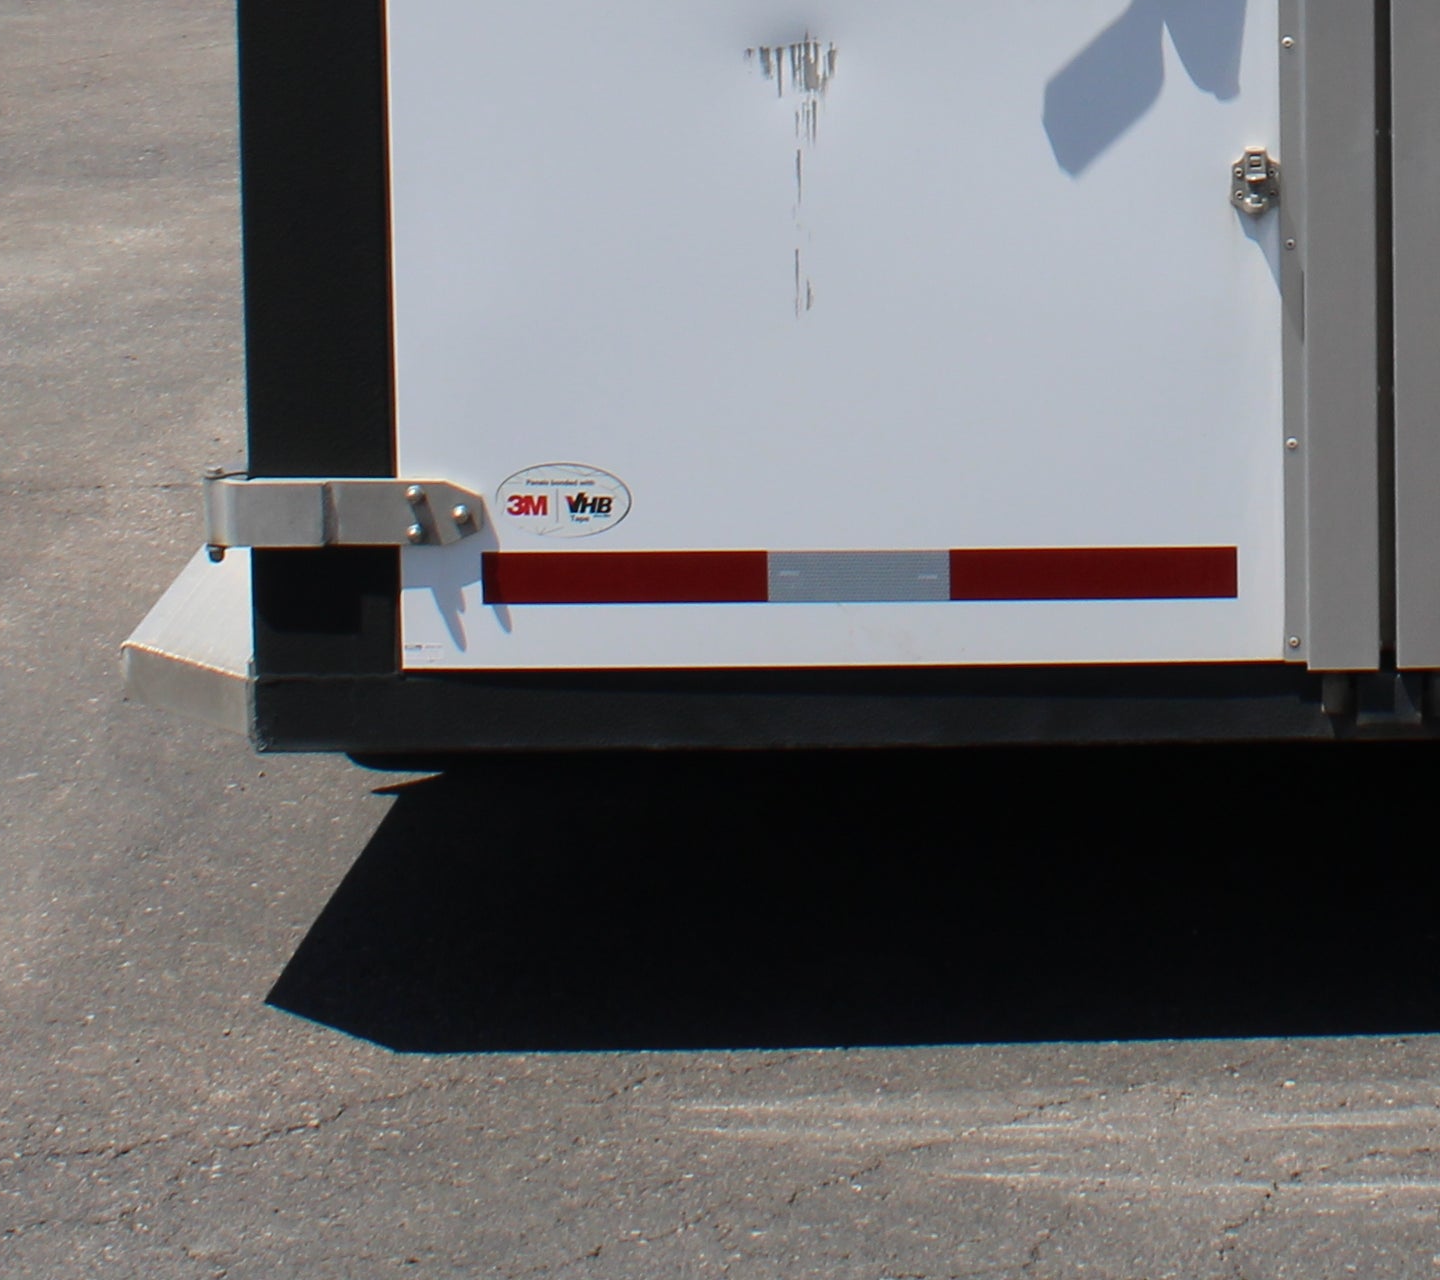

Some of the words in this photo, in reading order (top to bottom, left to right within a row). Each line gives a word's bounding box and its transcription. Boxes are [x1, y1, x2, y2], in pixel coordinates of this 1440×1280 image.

[507, 495, 548, 516] 3M
[565, 492, 613, 514] VHB
[570, 515, 590, 523] Tape
